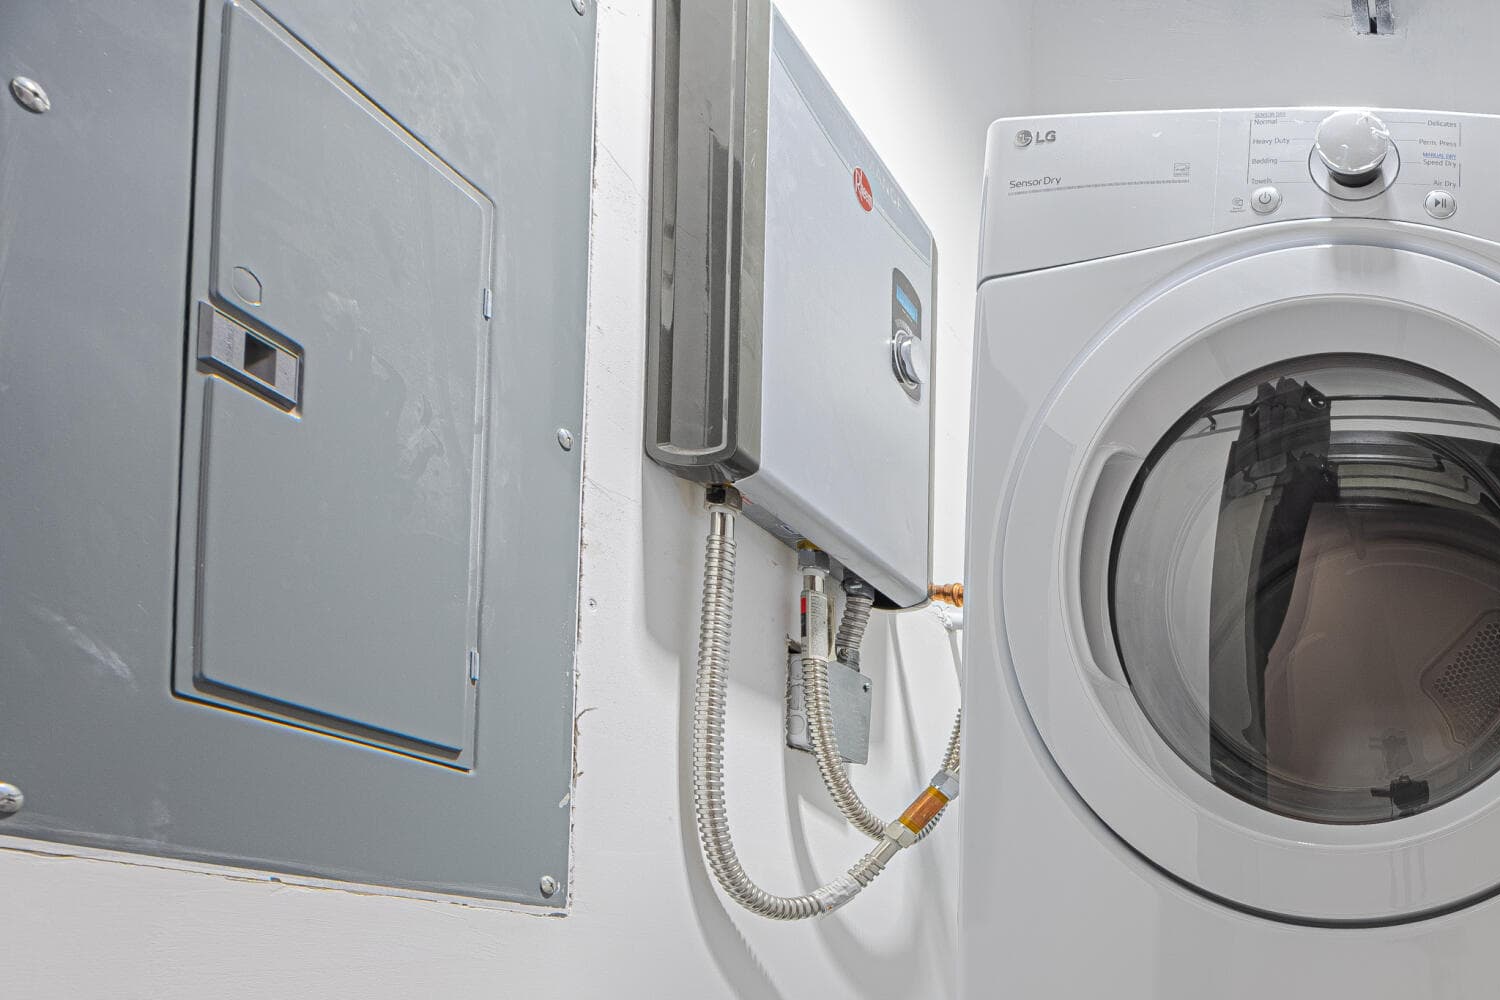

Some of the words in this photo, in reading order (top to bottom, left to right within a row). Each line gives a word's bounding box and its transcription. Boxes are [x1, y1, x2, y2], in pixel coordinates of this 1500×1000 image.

[1035, 130, 1056, 143] LG
[1423, 159, 1443, 167] Speed
[1445, 160, 1457, 168] Dry
[1009, 178, 1042, 189] Sensor
[1043, 176, 1062, 186] Dry
[1445, 180, 1457, 188] Dry
